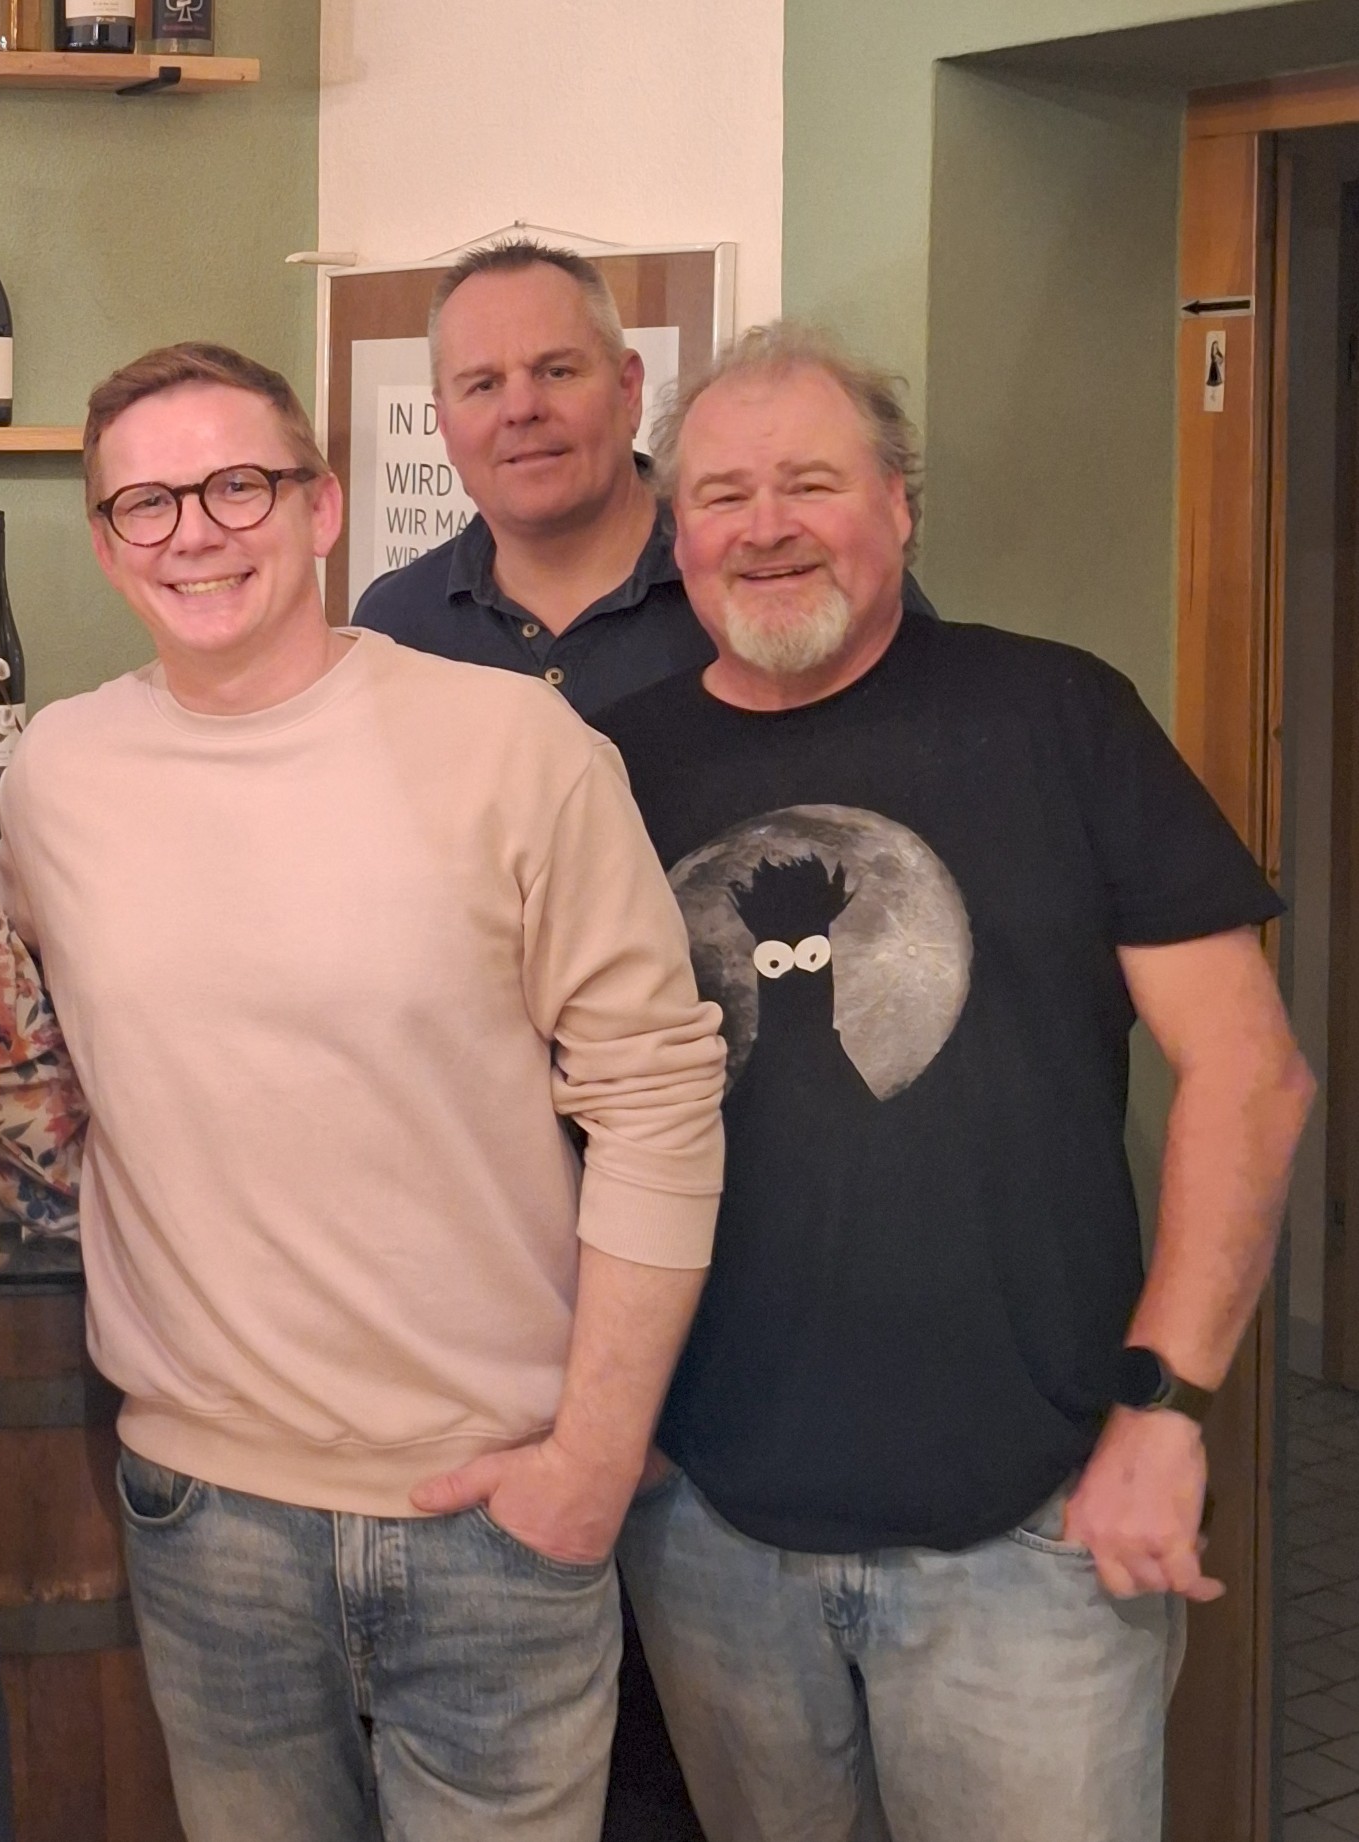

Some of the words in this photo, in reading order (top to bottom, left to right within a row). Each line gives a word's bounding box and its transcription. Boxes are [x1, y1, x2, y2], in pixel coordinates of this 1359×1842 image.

[389, 402, 413, 435] IN
[385, 462, 453, 497] WIRD
[386, 506, 427, 536] WIR
